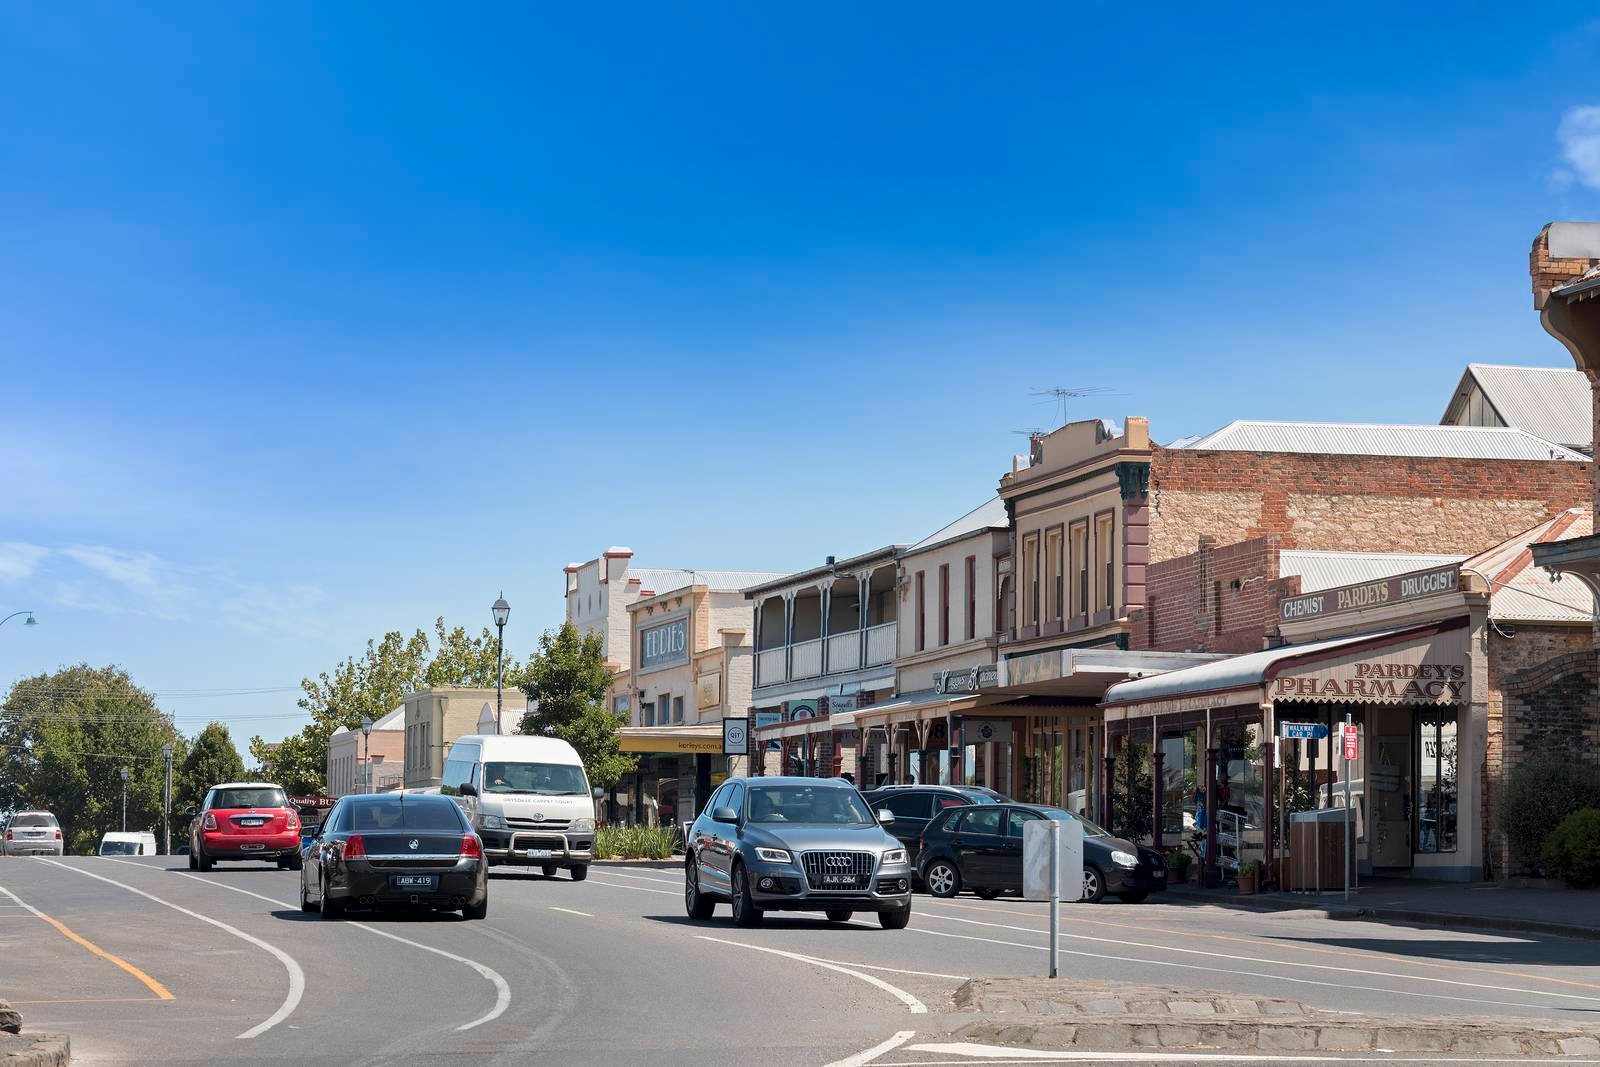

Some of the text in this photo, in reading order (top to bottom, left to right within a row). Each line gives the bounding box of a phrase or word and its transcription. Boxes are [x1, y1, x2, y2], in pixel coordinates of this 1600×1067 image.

[1283, 570, 1455, 617] CHEMIST PARDEYS DRUGGIST
[1354, 663, 1465, 679] PARDEYS
[1274, 677, 1467, 699] PHARMACY
[289, 797, 317, 806] Quality
